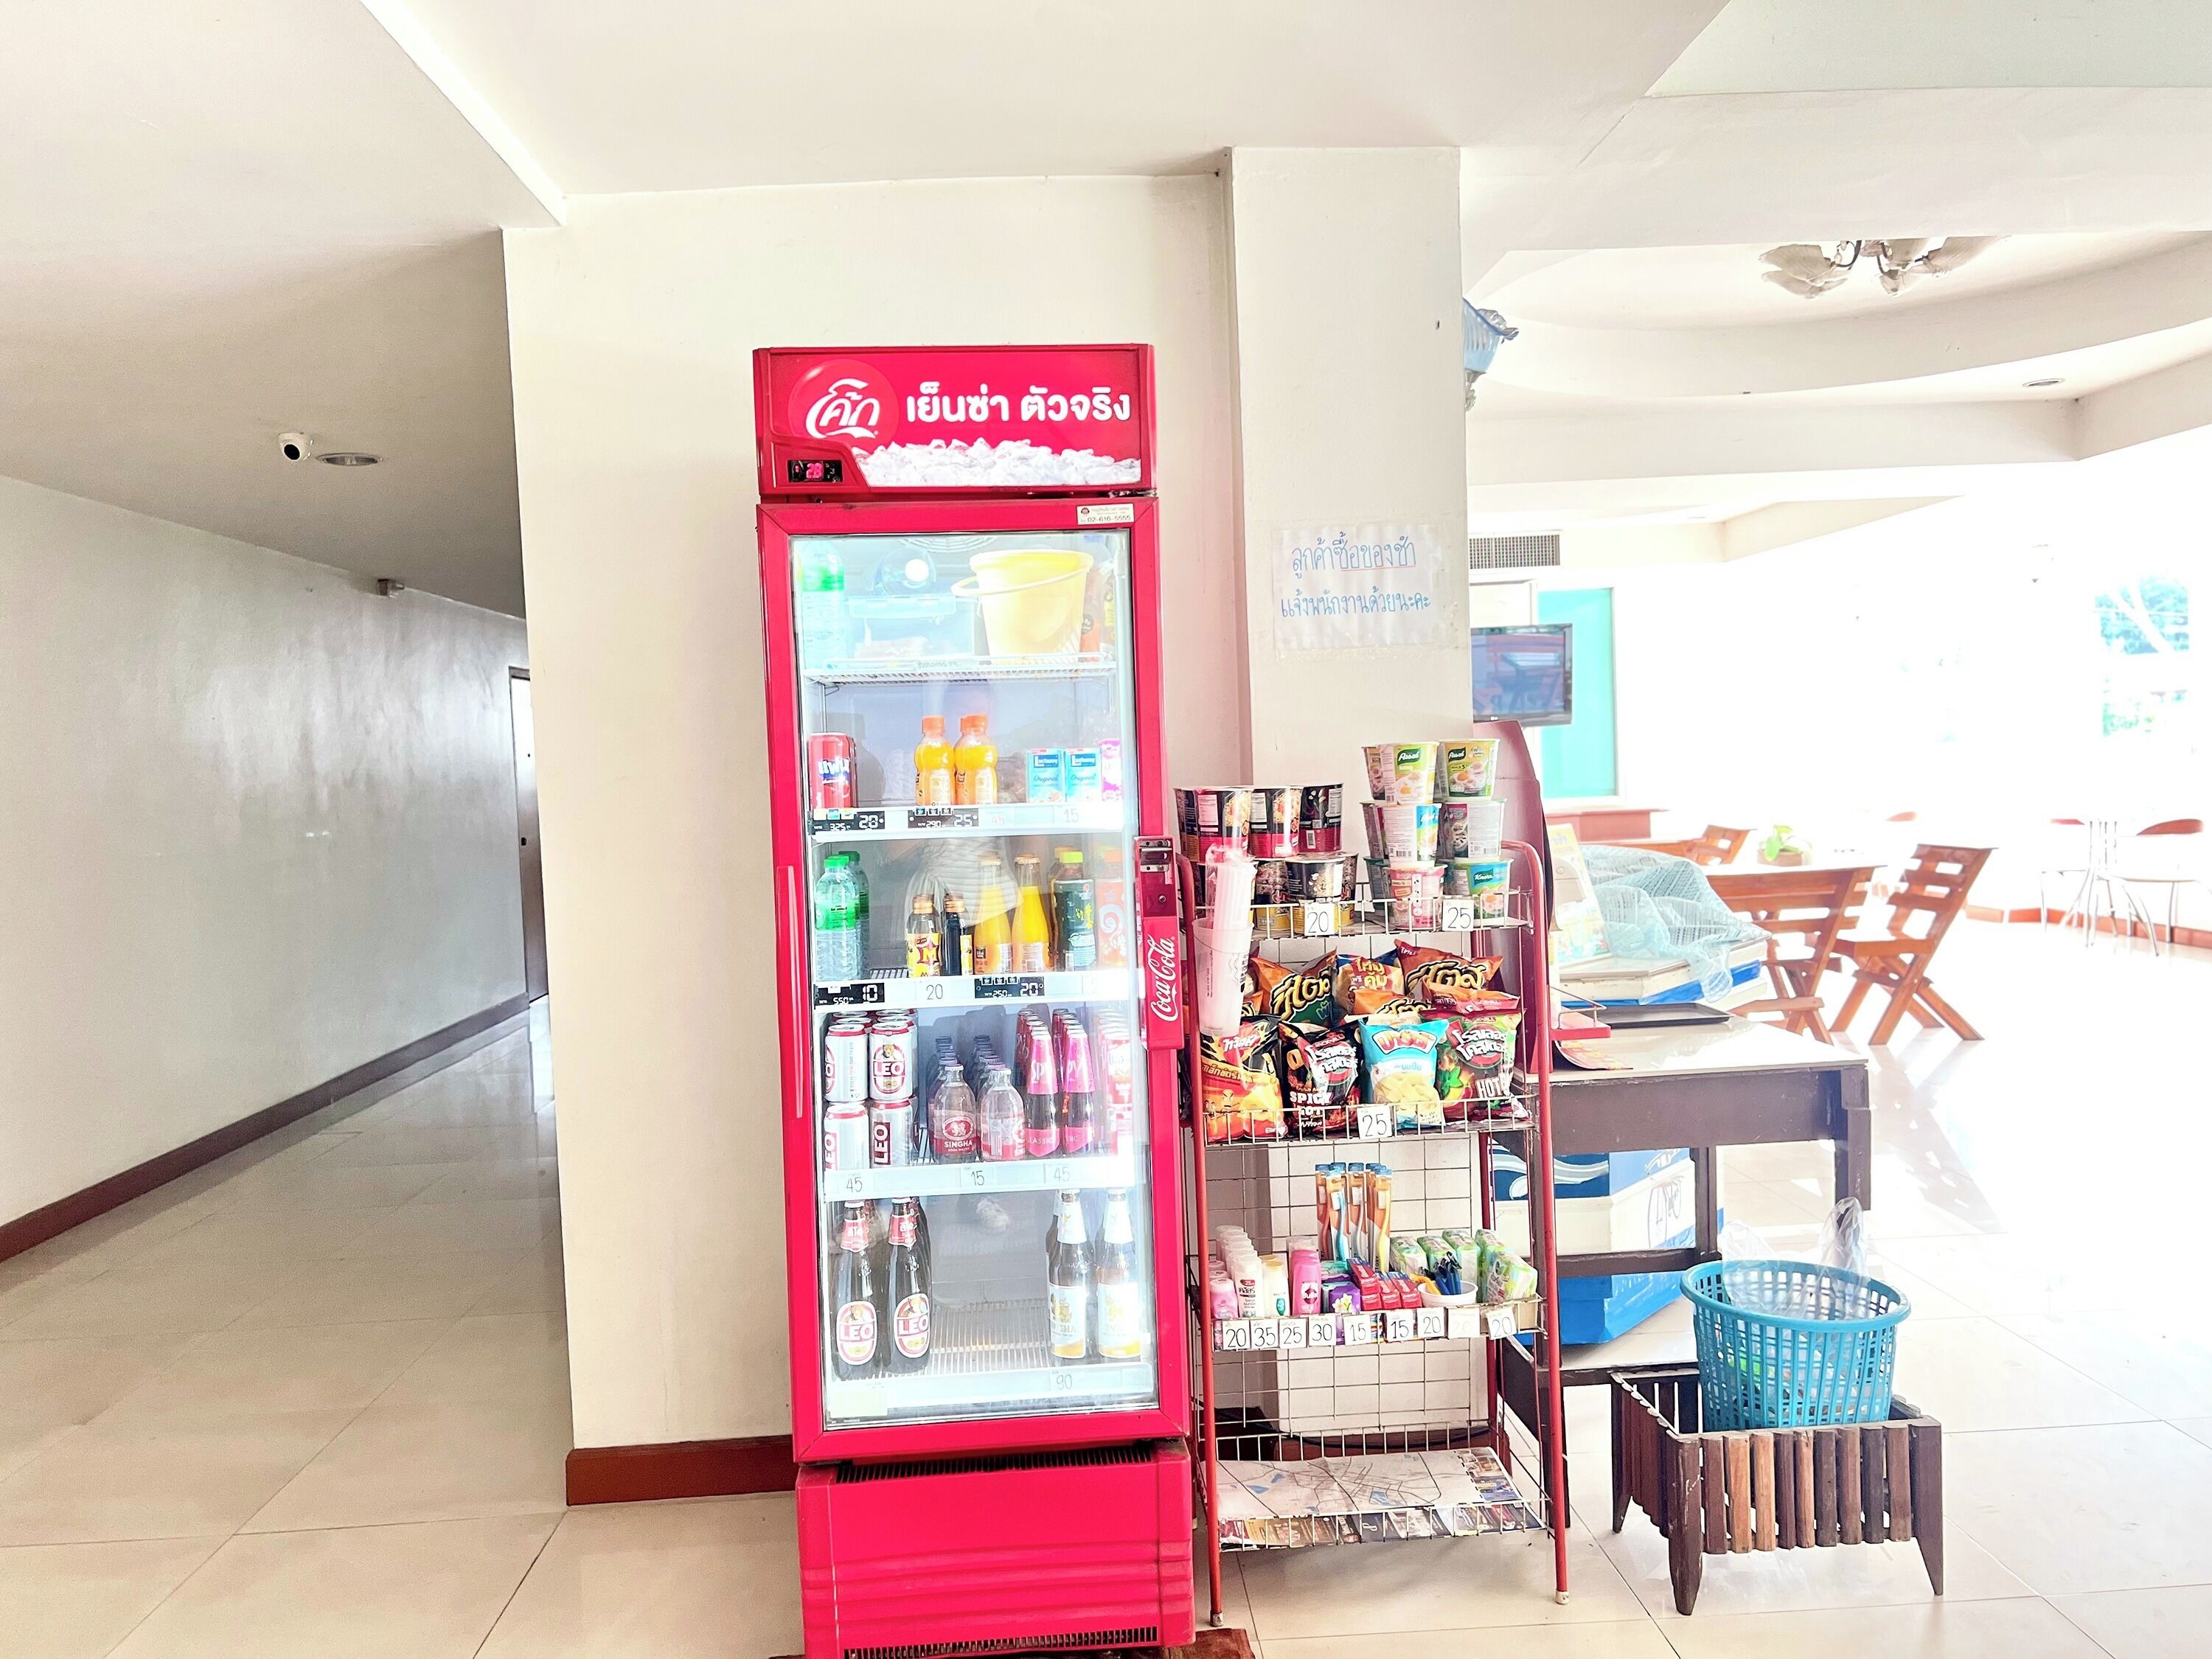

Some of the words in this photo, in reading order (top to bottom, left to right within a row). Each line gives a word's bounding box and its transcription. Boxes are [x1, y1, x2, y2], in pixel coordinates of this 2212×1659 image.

[906, 381, 1009, 422] เย็นซ่า
[1020, 386, 1131, 422] ตัวจริง
[1034, 774, 1059, 784] Original
[859, 815, 878, 830] 28
[953, 814, 973, 827] 25
[1064, 808, 1079, 823] 15
[1307, 911, 1329, 933] 20
[1447, 907, 1472, 930] 25
[1147, 934, 1179, 1022] Coca-Cola
[862, 984, 878, 1002] 10
[926, 984, 944, 1000] 20
[1020, 983, 1038, 997] 20
[874, 1062, 905, 1076] LEO
[1363, 1113, 1387, 1137] 25
[874, 1124, 888, 1164] LEO
[944, 1140, 973, 1148] SINGHA
[971, 1170, 985, 1186] 15
[1054, 1167, 1070, 1182] 45
[846, 1177, 863, 1192] 45
[840, 1324, 874, 1340] LEO
[898, 1315, 929, 1335] LEO
[1311, 1323, 1333, 1341] 30
[1350, 1323, 1366, 1342] 15
[1391, 1319, 1409, 1339] 15
[1423, 1316, 1442, 1334] 20
[1492, 1316, 1512, 1338] 20
[1225, 1327, 1247, 1348] 20
[1253, 1326, 1276, 1347] 35
[1282, 1326, 1302, 1344] 25
[1056, 1374, 1073, 1391] 90
